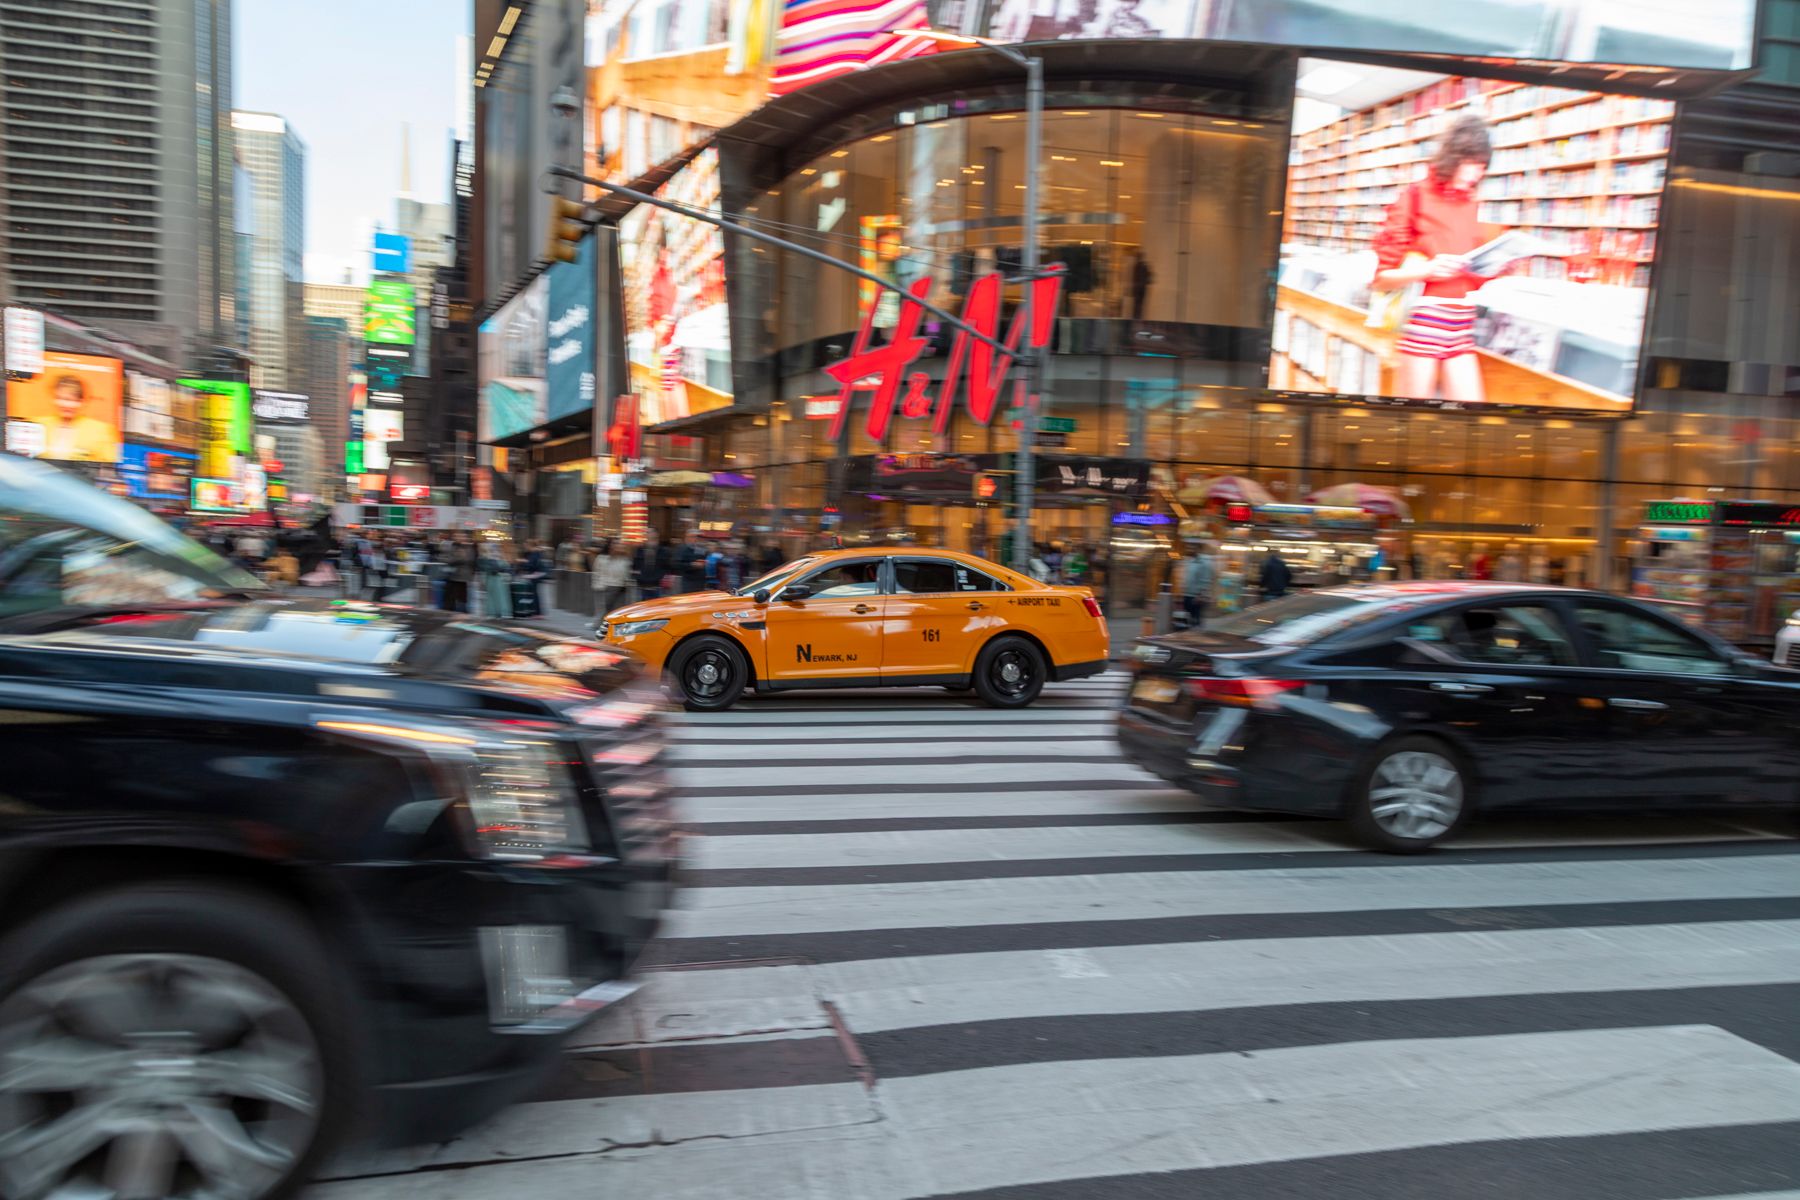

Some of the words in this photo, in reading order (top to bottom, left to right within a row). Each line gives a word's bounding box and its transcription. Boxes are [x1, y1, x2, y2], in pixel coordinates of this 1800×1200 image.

[825, 263, 1067, 442] H&M
[1017, 597, 1044, 606] AIRPORT
[1046, 598, 1061, 606] TAXI
[922, 629, 940, 642] 161
